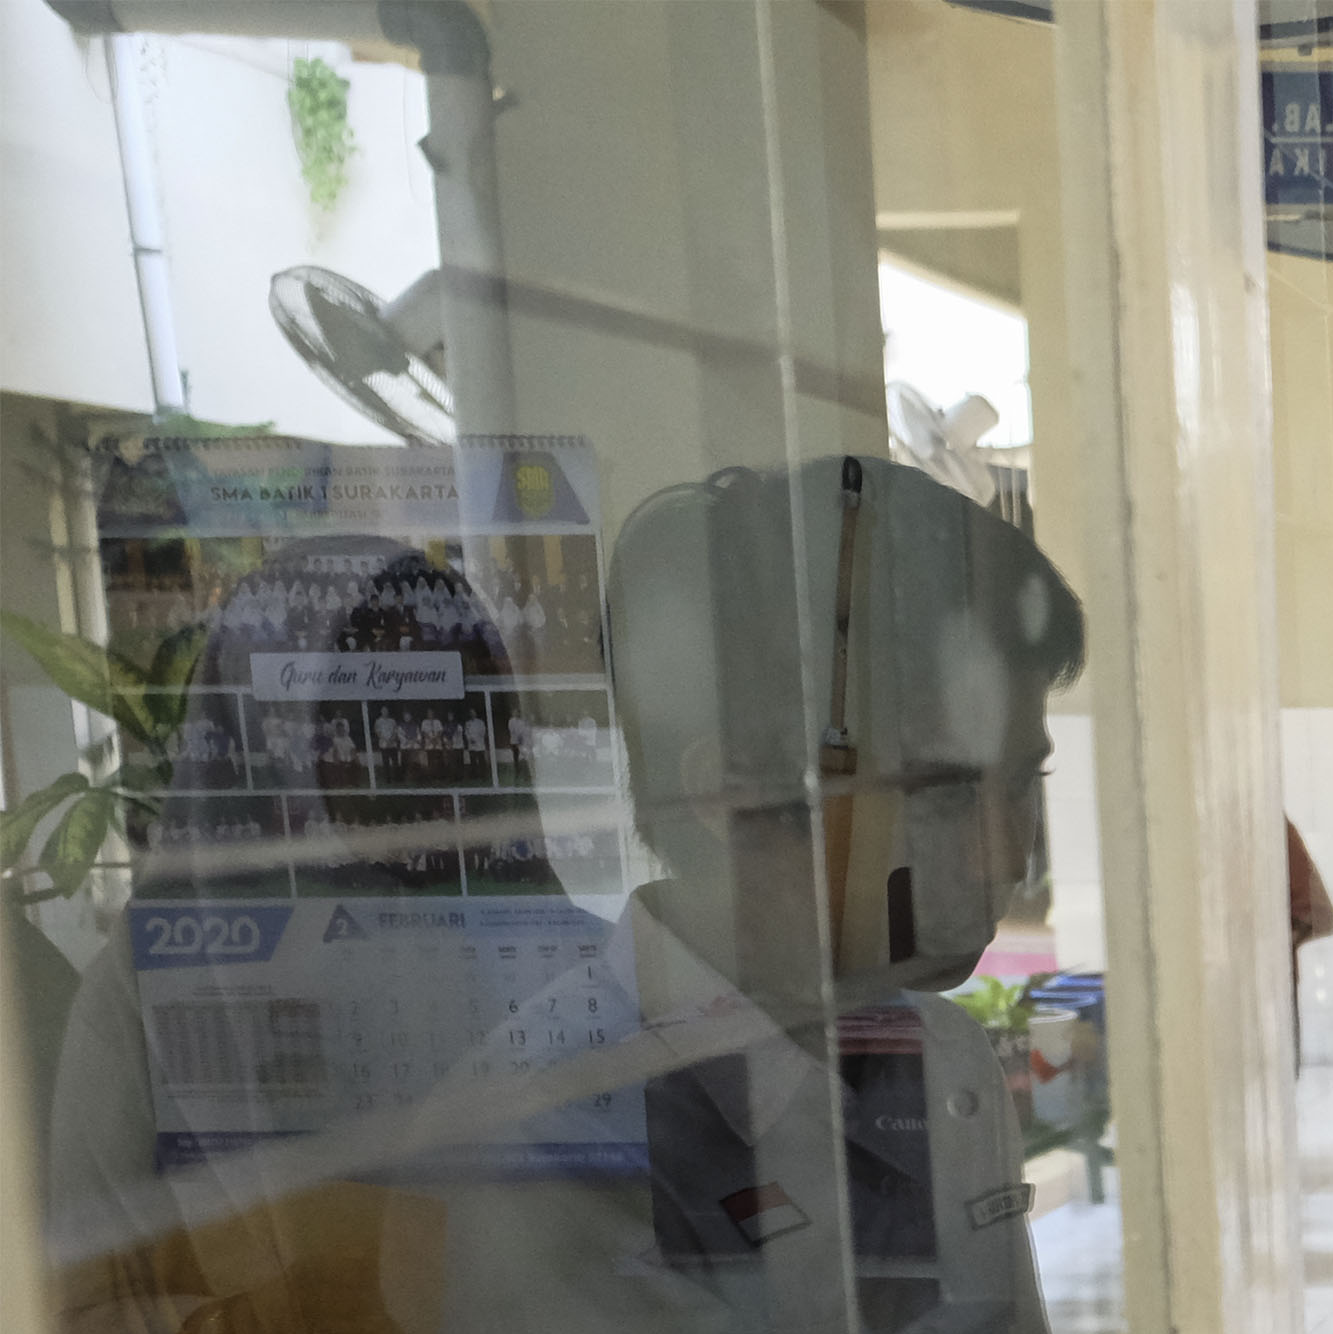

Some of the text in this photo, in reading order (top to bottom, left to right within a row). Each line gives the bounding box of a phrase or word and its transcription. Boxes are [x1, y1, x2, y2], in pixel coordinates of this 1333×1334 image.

[210, 486, 253, 502] SMA
[259, 485, 315, 501] BATIK
[332, 484, 459, 501] SURAKARTA
[328, 664, 357, 683] dan
[363, 661, 447, 692] Karyawan
[146, 916, 260, 955] 2020
[378, 913, 467, 928] FEBRUARI
[508, 999, 519, 1013] 6
[547, 999, 557, 1013] 7
[587, 998, 598, 1013] 8
[508, 1030, 526, 1045] 13
[547, 1029, 565, 1045] 14
[588, 1029, 606, 1044] 15
